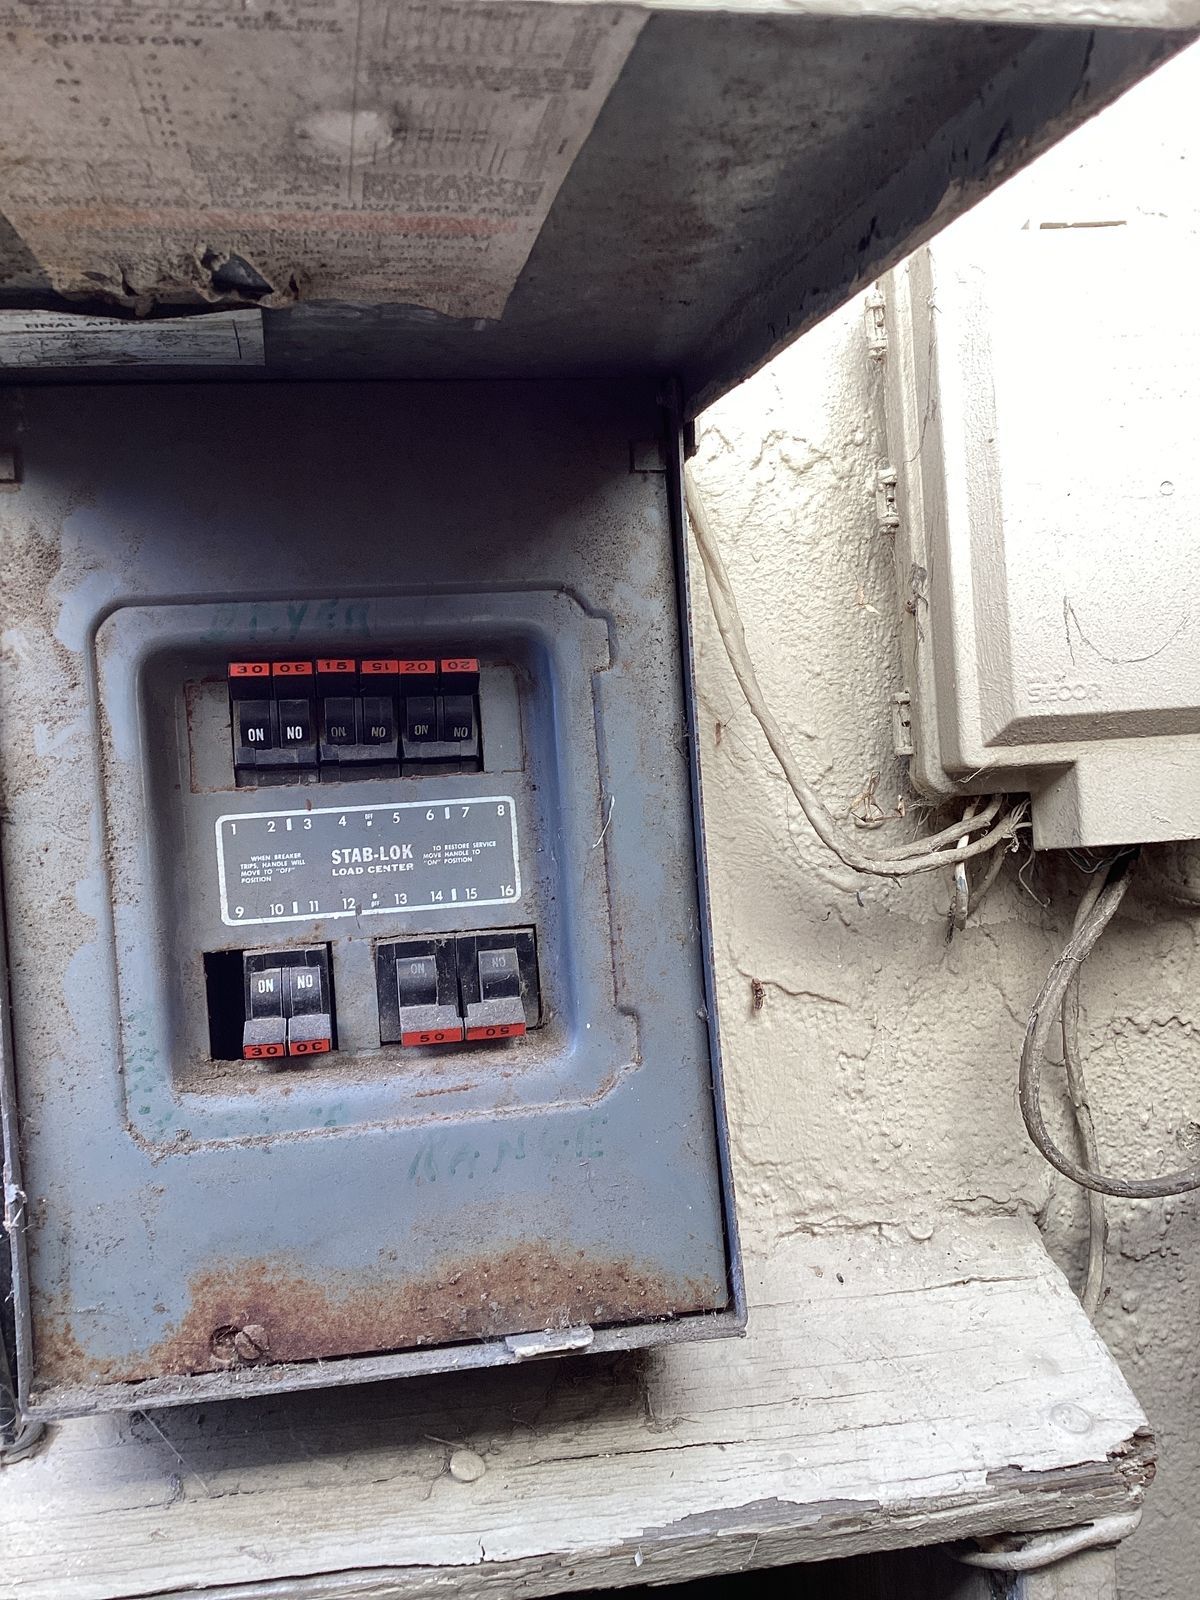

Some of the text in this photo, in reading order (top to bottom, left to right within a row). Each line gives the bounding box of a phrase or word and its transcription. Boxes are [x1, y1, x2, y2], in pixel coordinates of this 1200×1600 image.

[237, 665, 263, 674] 30
[325, 661, 347, 670] 15
[405, 662, 428, 671] 20
[248, 728, 265, 742] ON
[331, 726, 347, 737] ON
[414, 724, 429, 735] ON
[231, 824, 237, 835] 1
[267, 821, 276, 833] 2
[303, 818, 312, 830] 3
[338, 815, 347, 827] 4
[392, 812, 401, 824] 5
[426, 808, 435, 821] 6
[462, 806, 470, 818] 7
[497, 804, 505, 817] 8
[444, 842, 470, 850] RESTORE
[472, 840, 497, 848] SERVICE
[274, 852, 301, 860] BREAKER
[331, 843, 413, 865] STAB-LOK
[262, 860, 288, 868] HANDLE
[332, 863, 414, 876] LOAD CENTER
[235, 906, 244, 918] 9
[270, 903, 284, 916] 10
[308, 900, 319, 912] 11
[342, 897, 356, 910] 12
[394, 893, 407, 905] 13
[430, 890, 443, 902] 14
[465, 888, 478, 899] 15
[500, 884, 514, 896] 16
[410, 963, 425, 974] ON
[258, 978, 274, 994] ON
[419, 1033, 445, 1042] 50
[251, 1046, 278, 1056] 30
